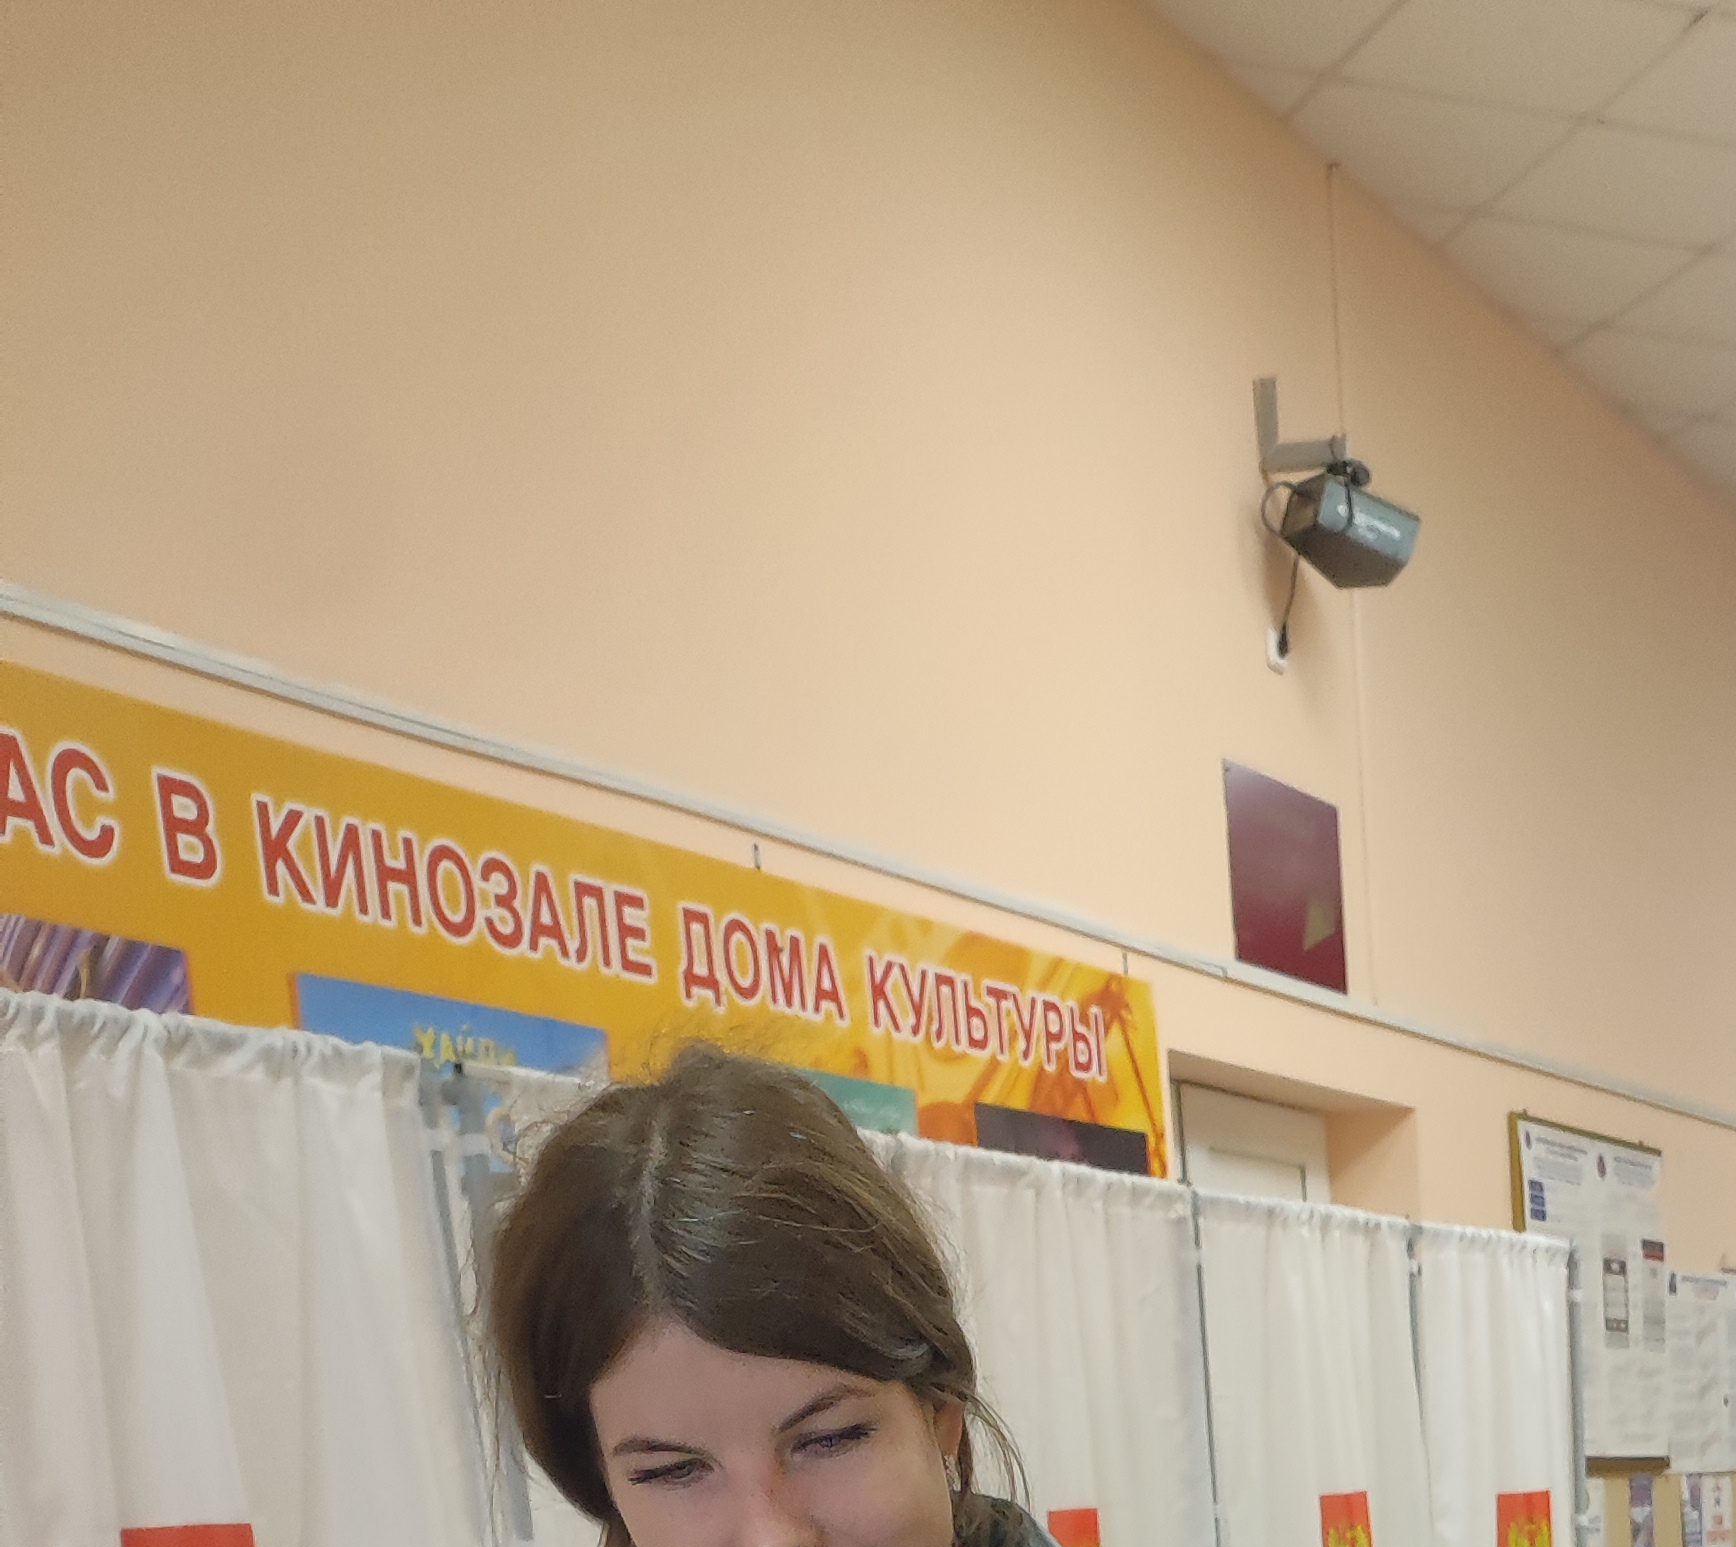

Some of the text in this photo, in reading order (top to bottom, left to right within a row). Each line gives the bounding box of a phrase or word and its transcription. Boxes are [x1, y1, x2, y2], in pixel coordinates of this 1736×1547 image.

[155, 770, 219, 882] В
[254, 798, 655, 979] КИНОЗАЛЕ
[681, 906, 847, 1021] ДОМА
[867, 953, 1108, 1081] КУЛЬТУРЫ
